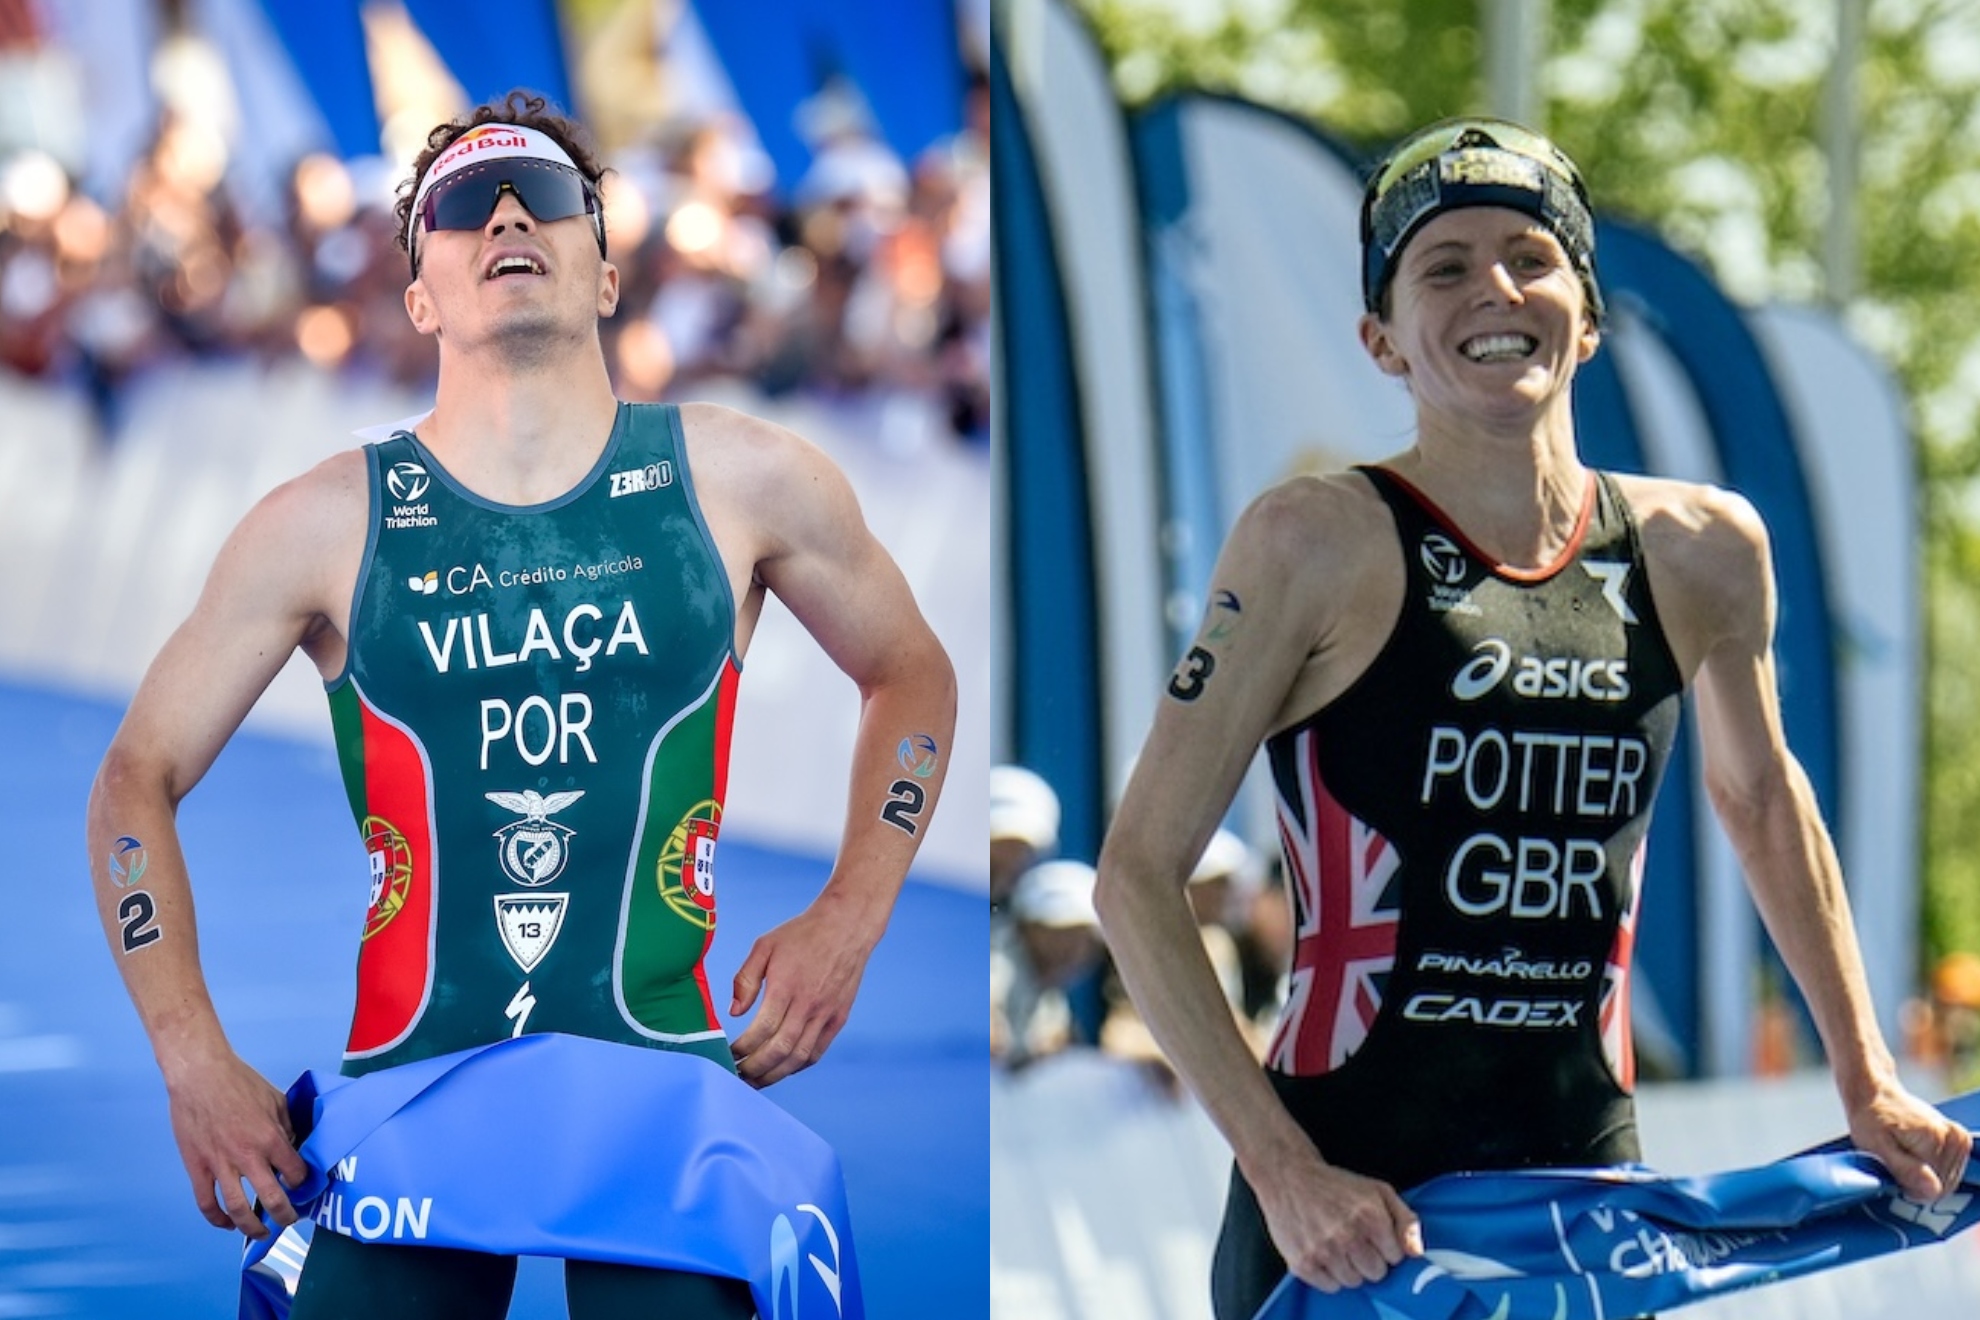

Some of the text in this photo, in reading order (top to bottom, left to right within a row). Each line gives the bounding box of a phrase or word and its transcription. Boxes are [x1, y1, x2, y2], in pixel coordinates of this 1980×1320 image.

[433, 136, 527, 175] Red Bull
[385, 514, 438, 529] Triathlon
[393, 504, 429, 517] World
[447, 555, 643, 595] CA Crédito Agrícola
[417, 600, 649, 674] VILAÇA
[1168, 645, 1216, 702] 3
[1513, 657, 1631, 700] asics
[480, 692, 598, 770] POR
[1421, 727, 1647, 816] POTTER
[879, 777, 926, 838] 2
[1446, 832, 1606, 919] GBR
[117, 889, 163, 955] 2
[518, 923, 541, 938] 13
[1417, 953, 1593, 979] PINARELLO
[1403, 994, 1584, 1028] CADEX
